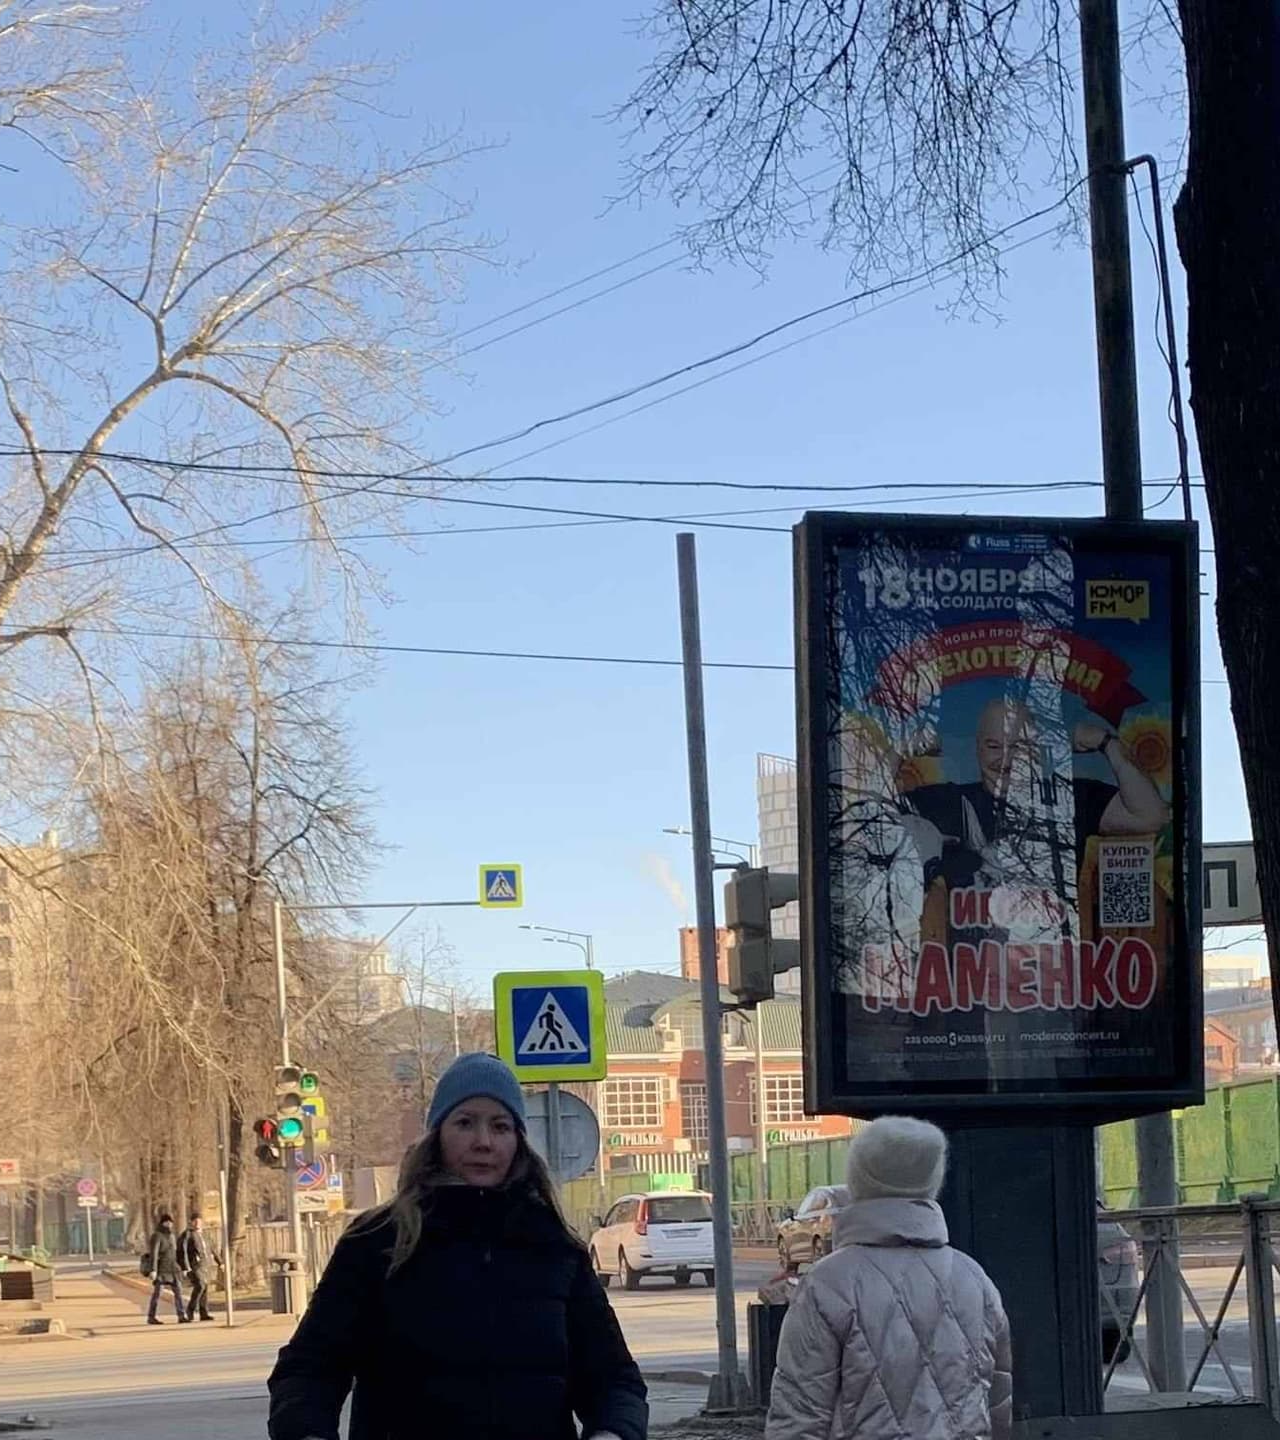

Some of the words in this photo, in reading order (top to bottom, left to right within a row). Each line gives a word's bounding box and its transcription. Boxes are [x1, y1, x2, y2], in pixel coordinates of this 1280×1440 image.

[858, 566, 910, 609] 18
[1090, 585, 1144, 603] ЮМОР
[1090, 601, 1116, 614] FM
[944, 629, 985, 646] НОВАЯ
[1102, 846, 1150, 857] КУПИТЬ
[1107, 858, 1145, 868] БИЛЕТ
[1020, 1031, 1120, 1040] modernconcert.ru
